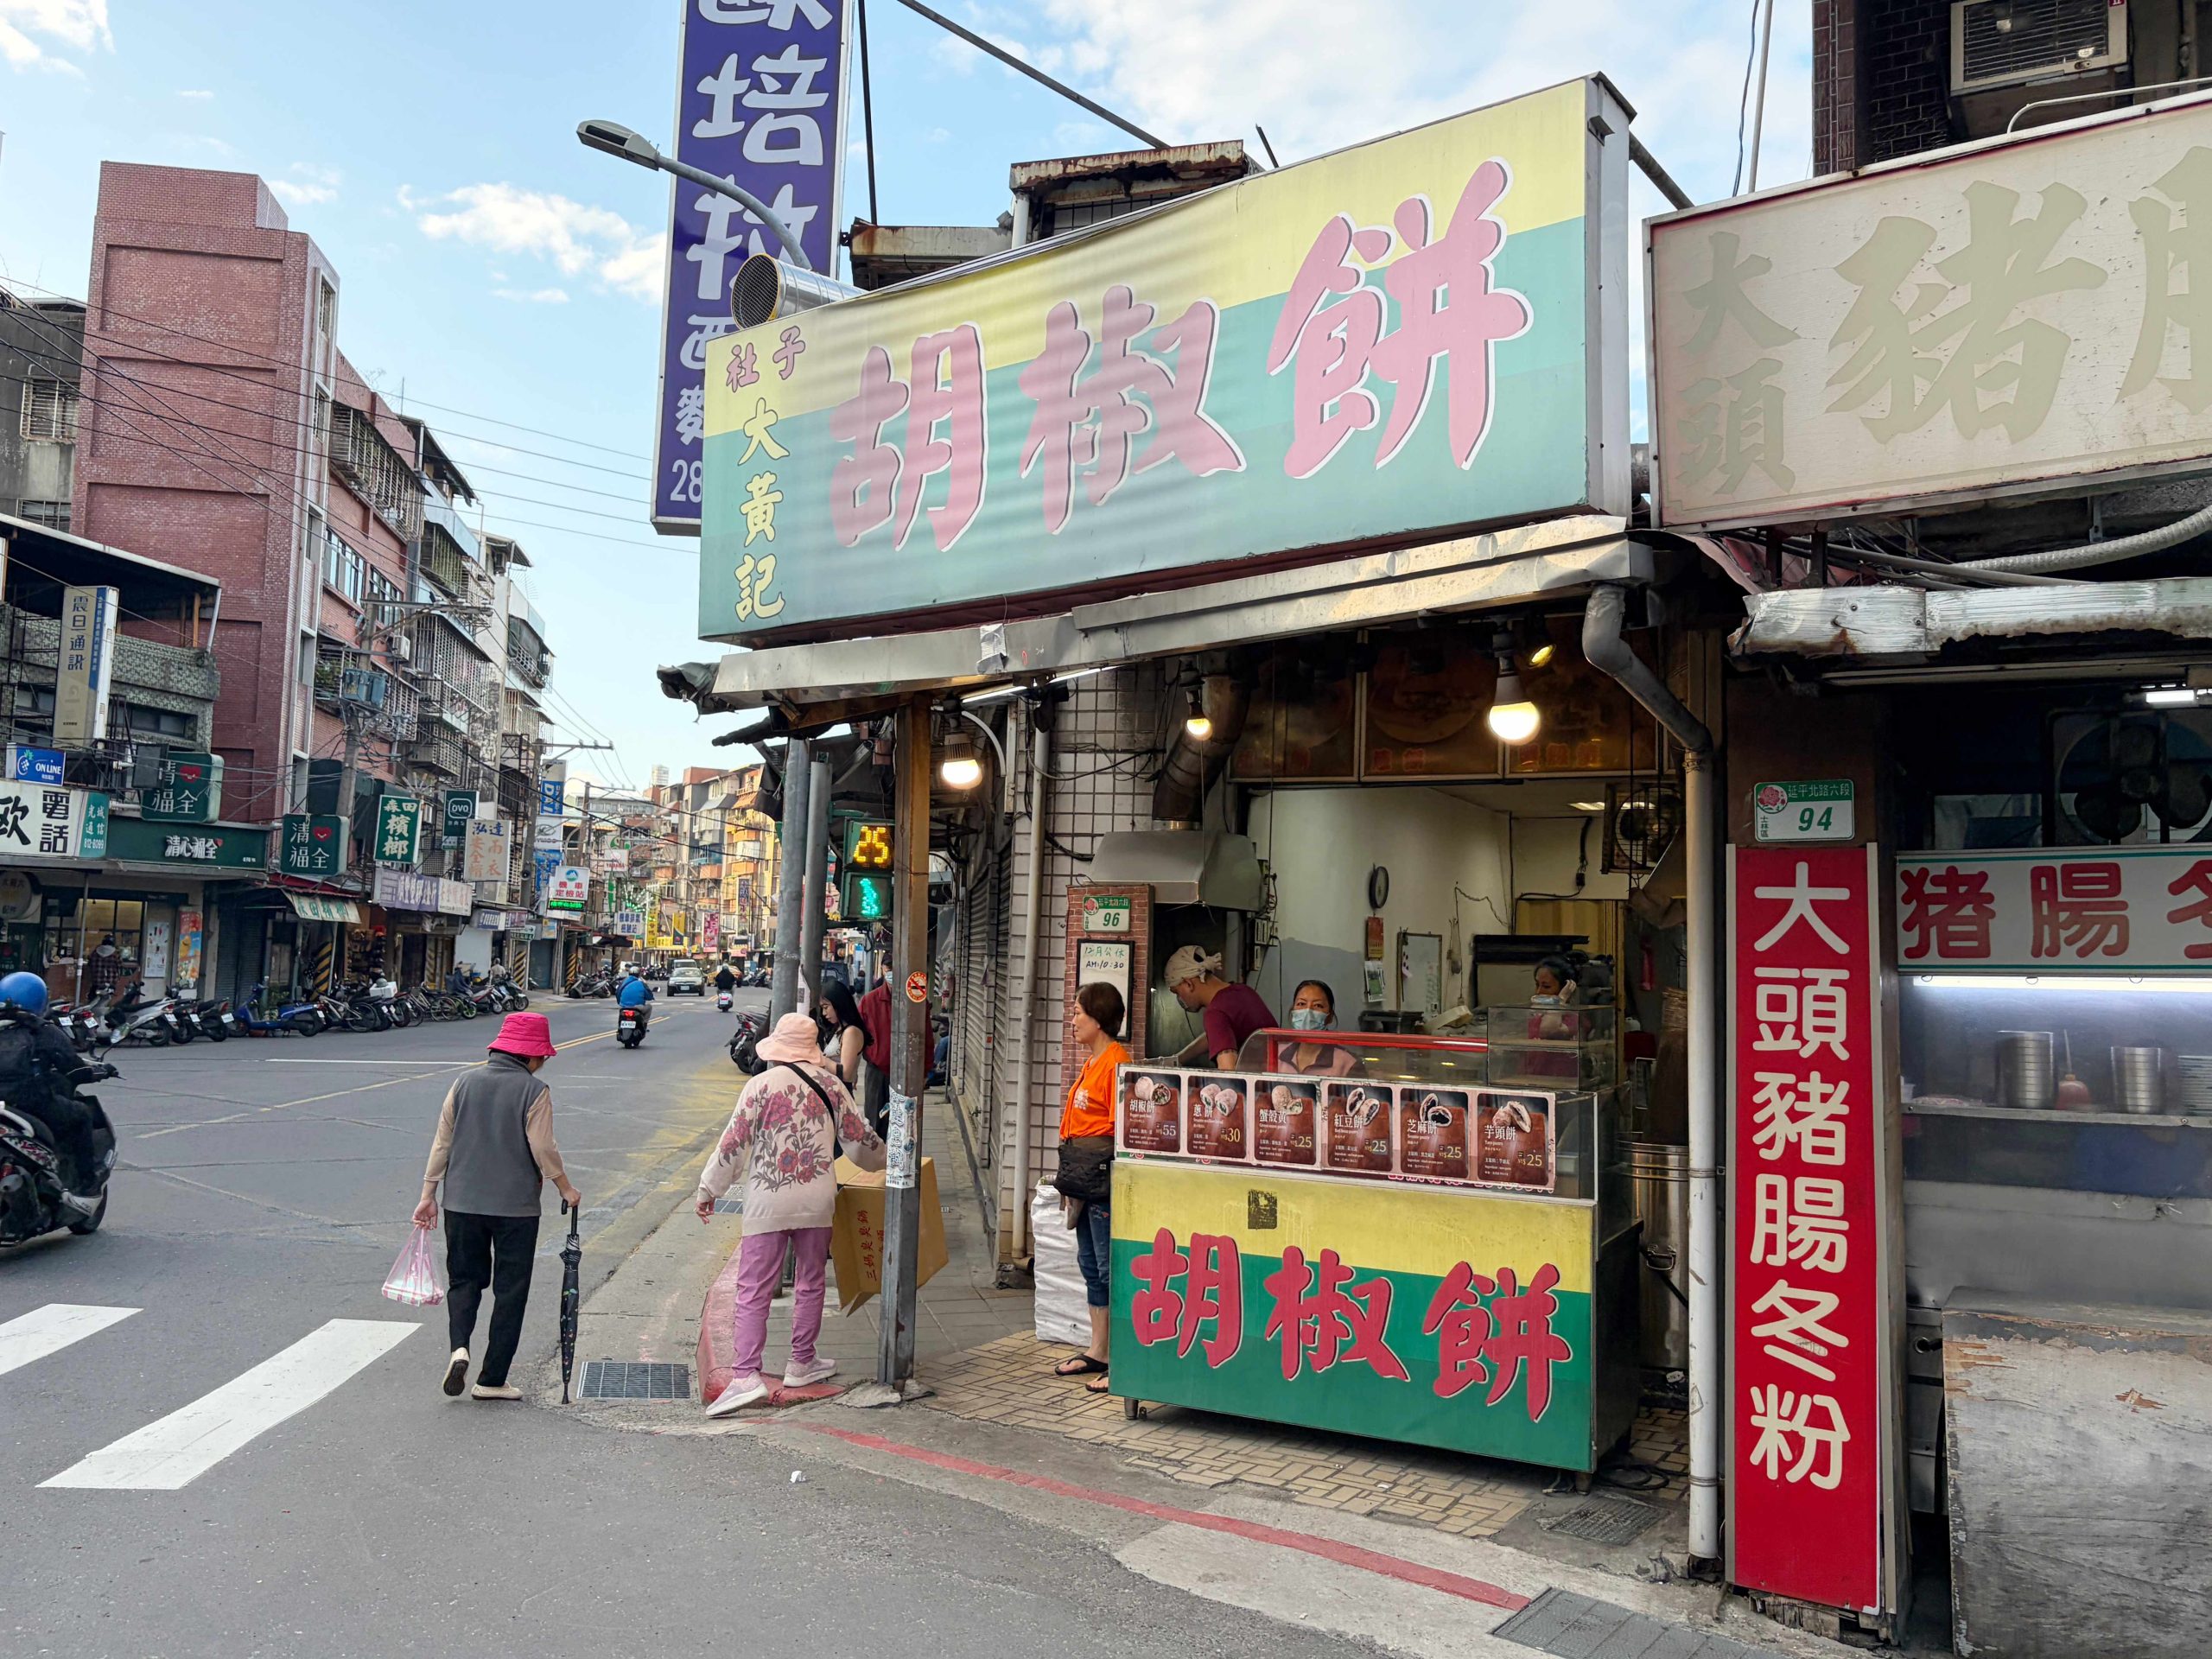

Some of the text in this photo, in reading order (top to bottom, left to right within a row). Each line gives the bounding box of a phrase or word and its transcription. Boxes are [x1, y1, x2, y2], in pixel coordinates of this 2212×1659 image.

[727, 327, 805, 392] 社子
[830, 157, 1533, 551] 胡椒餅
[1676, 232, 1801, 494] 大頭
[35, 762, 62, 775] ON LINE
[152, 789, 199, 814] 福全
[1788, 783, 1850, 798] 延平北路六段
[384, 799, 418, 813] 森田
[40, 791, 70, 853] 電話
[472, 822, 504, 837] 泓達
[1798, 807, 1833, 831] 94
[289, 822, 309, 844] 清
[382, 814, 410, 860] 檳榔
[853, 825, 888, 863] 25
[165, 836, 218, 860] 清心福全
[289, 846, 330, 869] 福全
[1103, 912, 1120, 926] 96
[1129, 1098, 1155, 1114] 胡椒餅
[1333, 1114, 1364, 1129] 紅豆餅
[1407, 1119, 1439, 1136] 芝麻餅
[1484, 1125, 1517, 1141] 芋頭餅
[1750, 861, 1851, 1491] 大頭豬腸冬粉
[1130, 1228, 1574, 1423] 胡椒餅
